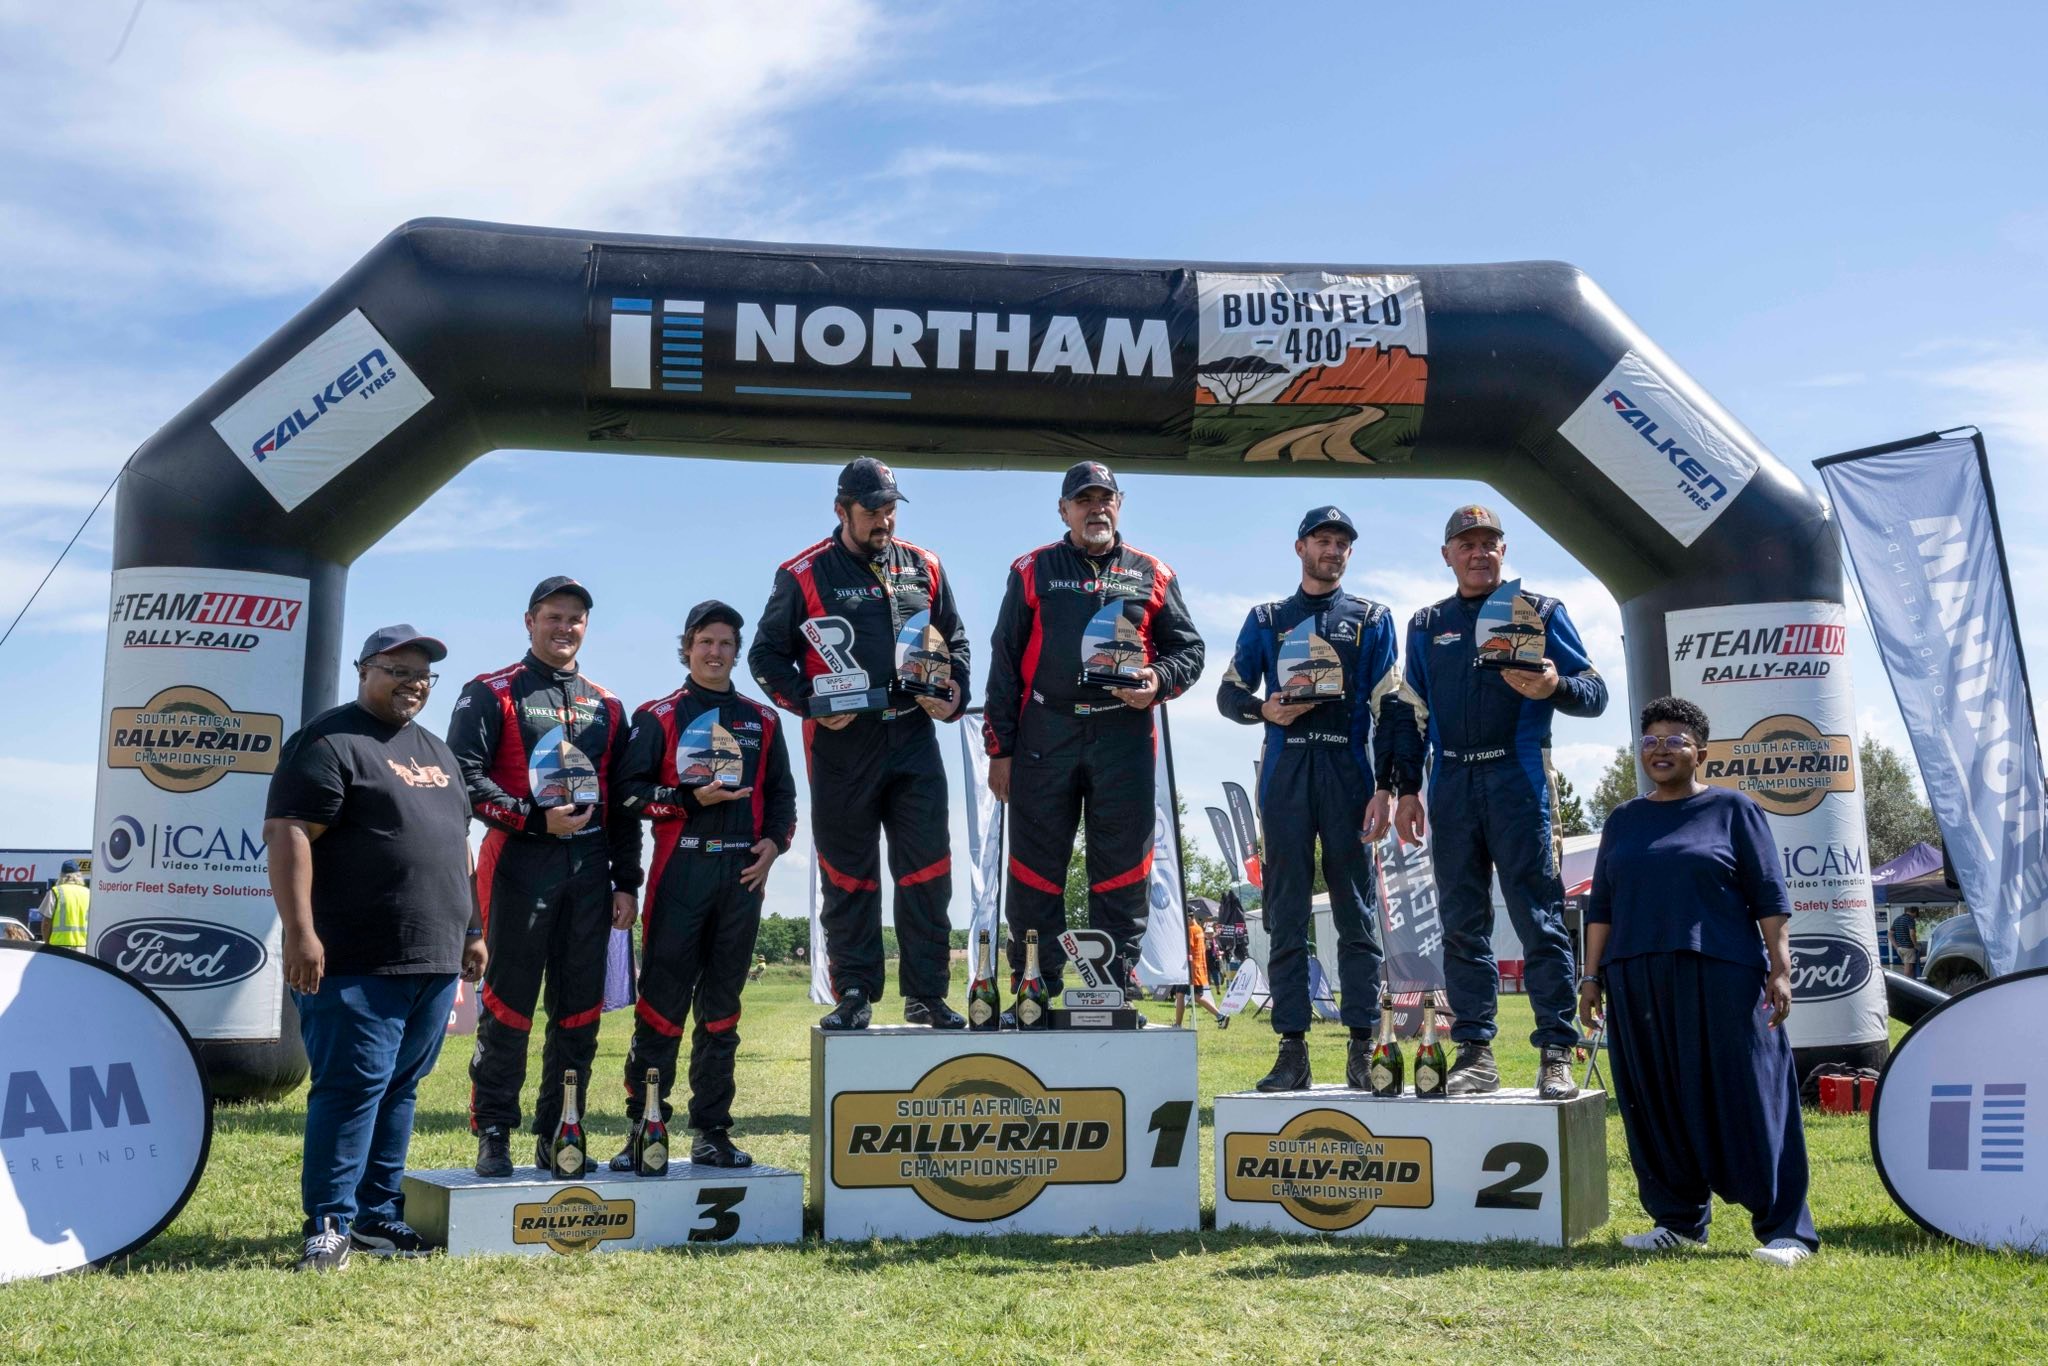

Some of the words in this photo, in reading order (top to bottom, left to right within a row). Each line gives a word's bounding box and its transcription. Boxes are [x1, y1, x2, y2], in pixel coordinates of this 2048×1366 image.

[1223, 291, 1401, 328] BUSHVELD
[735, 301, 1174, 378] NORTHAM
[359, 367, 397, 400] TYRES
[251, 348, 389, 462] FALKEN
[1603, 389, 1728, 502] FALKEN
[1676, 480, 1712, 511] TYRES
[836, 588, 870, 598] SIRKEL
[1050, 580, 1081, 589] SIRKEL
[1102, 581, 1137, 593] RACING
[124, 629, 260, 649] RALLY-RAID
[804, 621, 844, 674] RED-LINED
[1701, 661, 1831, 682] RALLY-RAID
[136, 713, 176, 725] SOUTH
[180, 714, 242, 729] AFRICAN
[527, 707, 559, 717] SIRKEL
[114, 728, 273, 753] RALLY-RAID
[735, 738, 759, 747] ACING
[1733, 742, 1778, 755] SOUTH
[1781, 739, 1830, 752] AFRICAN
[135, 751, 237, 767] CHAMPIONSHIP
[1705, 755, 1850, 779] RALLY-RAID
[1738, 776, 1832, 792] CHAMPIONSHIP
[162, 824, 268, 862] iCAM
[162, 861, 199, 871] Video
[204, 862, 268, 874] Telematic
[1783, 845, 1864, 878] iCAM
[98, 880, 133, 893] Superior
[135, 881, 164, 893] Fleet
[167, 883, 209, 898] Safety
[212, 884, 273, 898] Solutions
[1785, 880, 1818, 889] Video
[1822, 878, 1866, 887] Telematics
[1794, 900, 1829, 912] Safety
[1831, 898, 1867, 910] Solutions
[116, 928, 230, 978] Ford
[1062, 933, 1098, 989] RED-LINED
[897, 1099, 967, 1117] SOUTH
[972, 1098, 1062, 1116] AFRICAN
[848, 1121, 1110, 1154] RALLY-RAID
[1147, 1100, 1194, 1168] 1
[1268, 1140, 1317, 1155] SOUTH
[1320, 1141, 1385, 1156] AFRICAN
[900, 1158, 1058, 1178] CHAMPIONSHIP
[1236, 1157, 1421, 1184] RALLY-RAID
[1474, 1142, 1549, 1210] 2
[1271, 1183, 1383, 1200] CHAMPIONSHIP
[541, 1205, 570, 1215] SOUTH
[572, 1203, 608, 1213] AFRICAN
[687, 1186, 748, 1242] 3
[520, 1213, 628, 1230] RALLY-RAID
[541, 1229, 607, 1240] CHAMPIONSHIP
